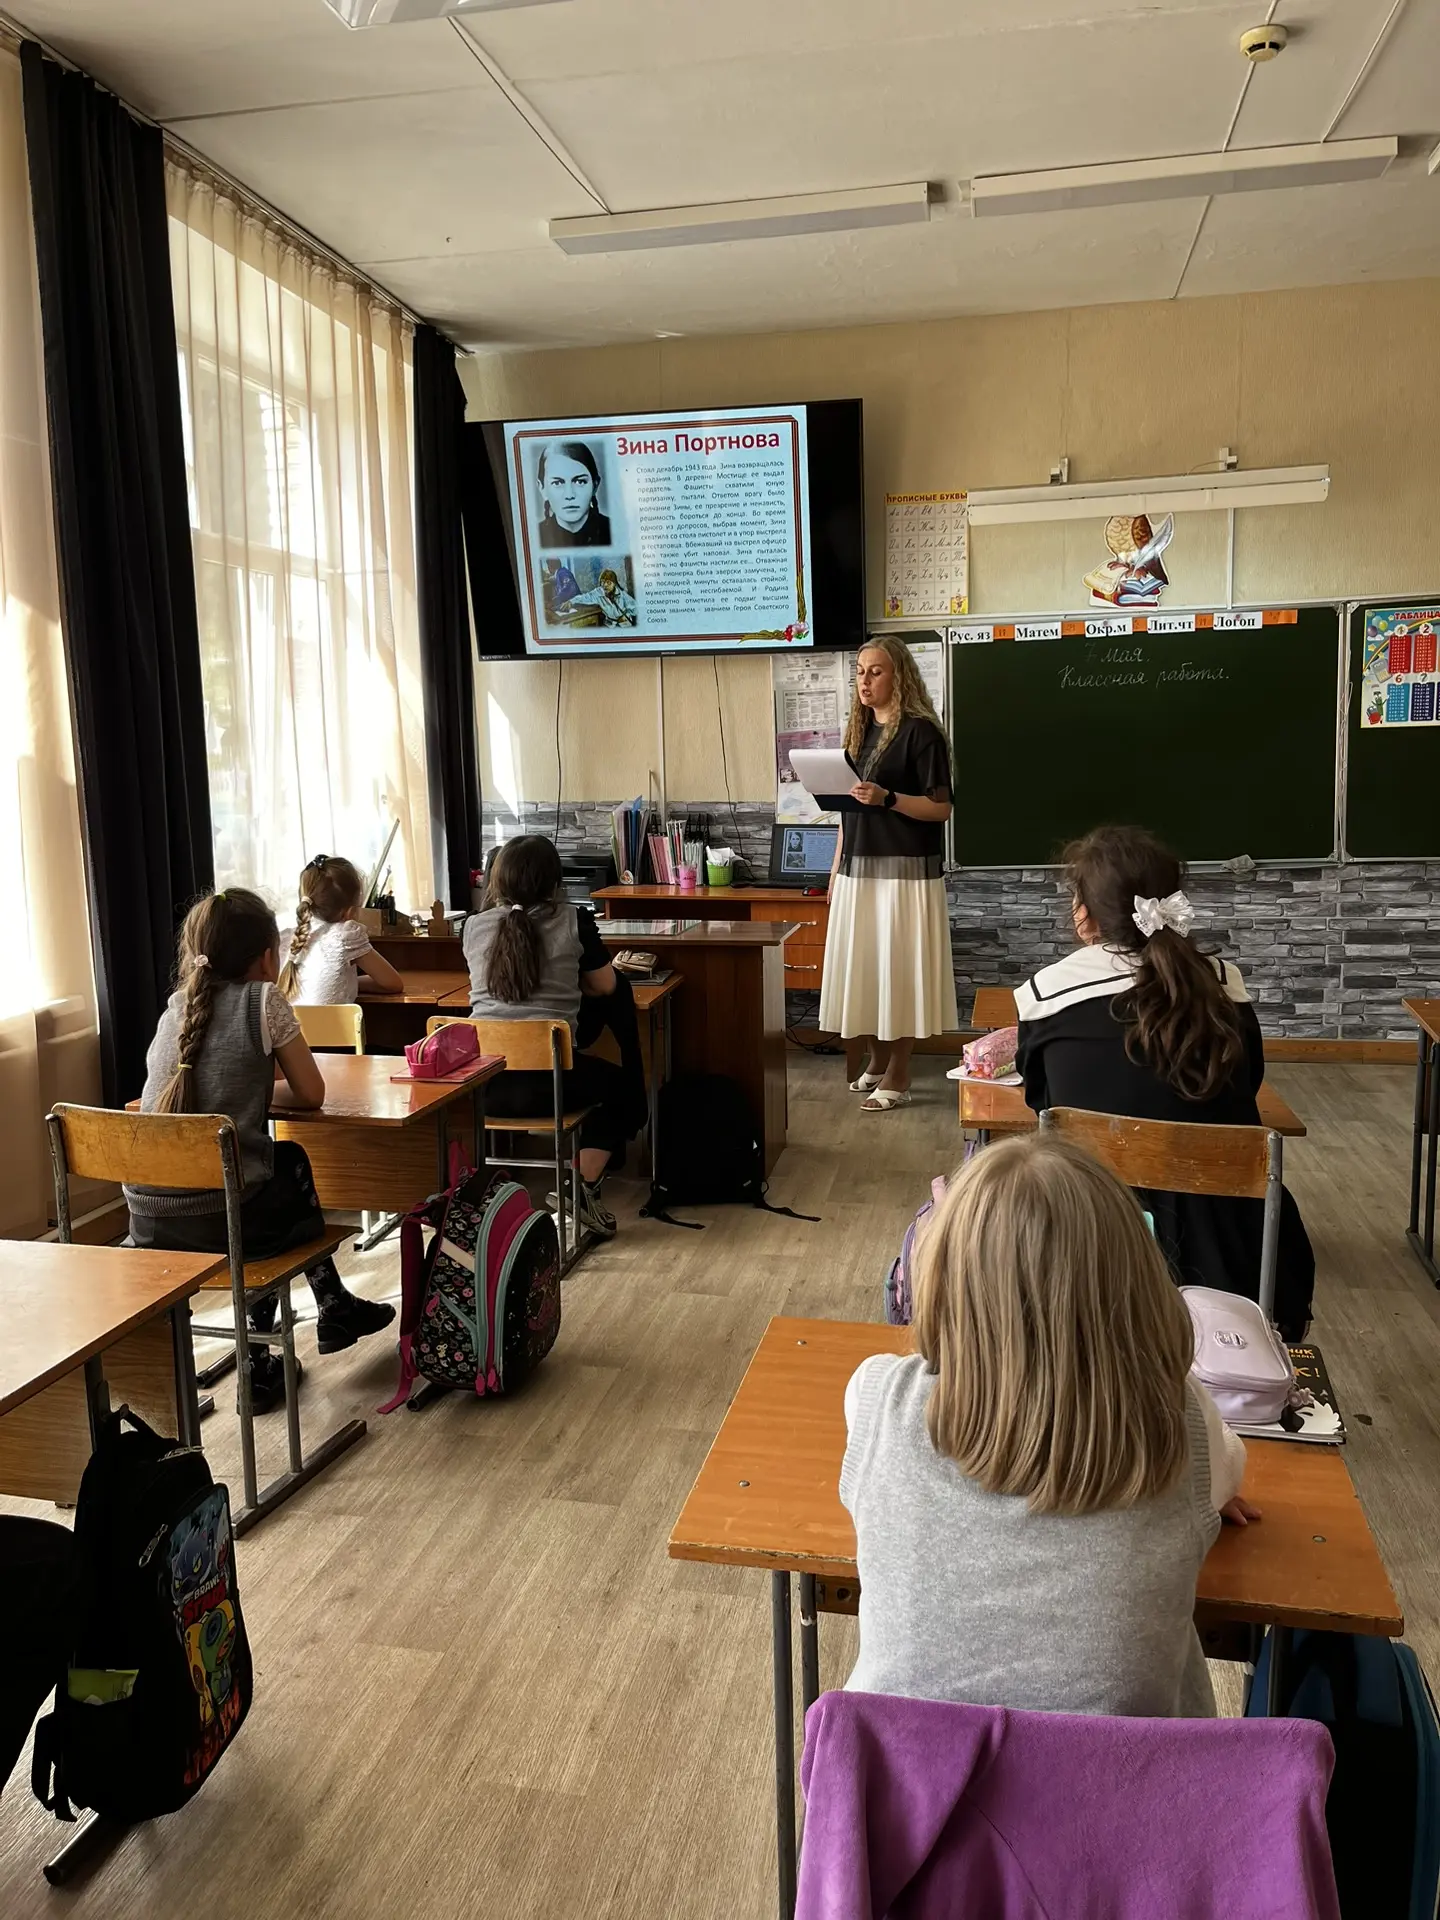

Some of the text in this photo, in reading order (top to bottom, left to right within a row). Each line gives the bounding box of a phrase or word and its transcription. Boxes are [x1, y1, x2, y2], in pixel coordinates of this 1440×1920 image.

[617, 432, 780, 455] Зина Портнова
[940, 492, 967, 500] БУКВЫ
[1148, 620, 1193, 631] Лит.чт
[1214, 616, 1255, 628] Логоп
[1016, 627, 1058, 638] Матем
[1086, 623, 1126, 637] Окр.м
[1423, 624, 1429, 633] 2
[950, 630, 973, 642] Рус.
[977, 632, 990, 640] яз
[1058, 664, 1148, 689] Классная
[1395, 674, 1402, 683] 6
[194, 1573, 220, 1600] BRAWL
